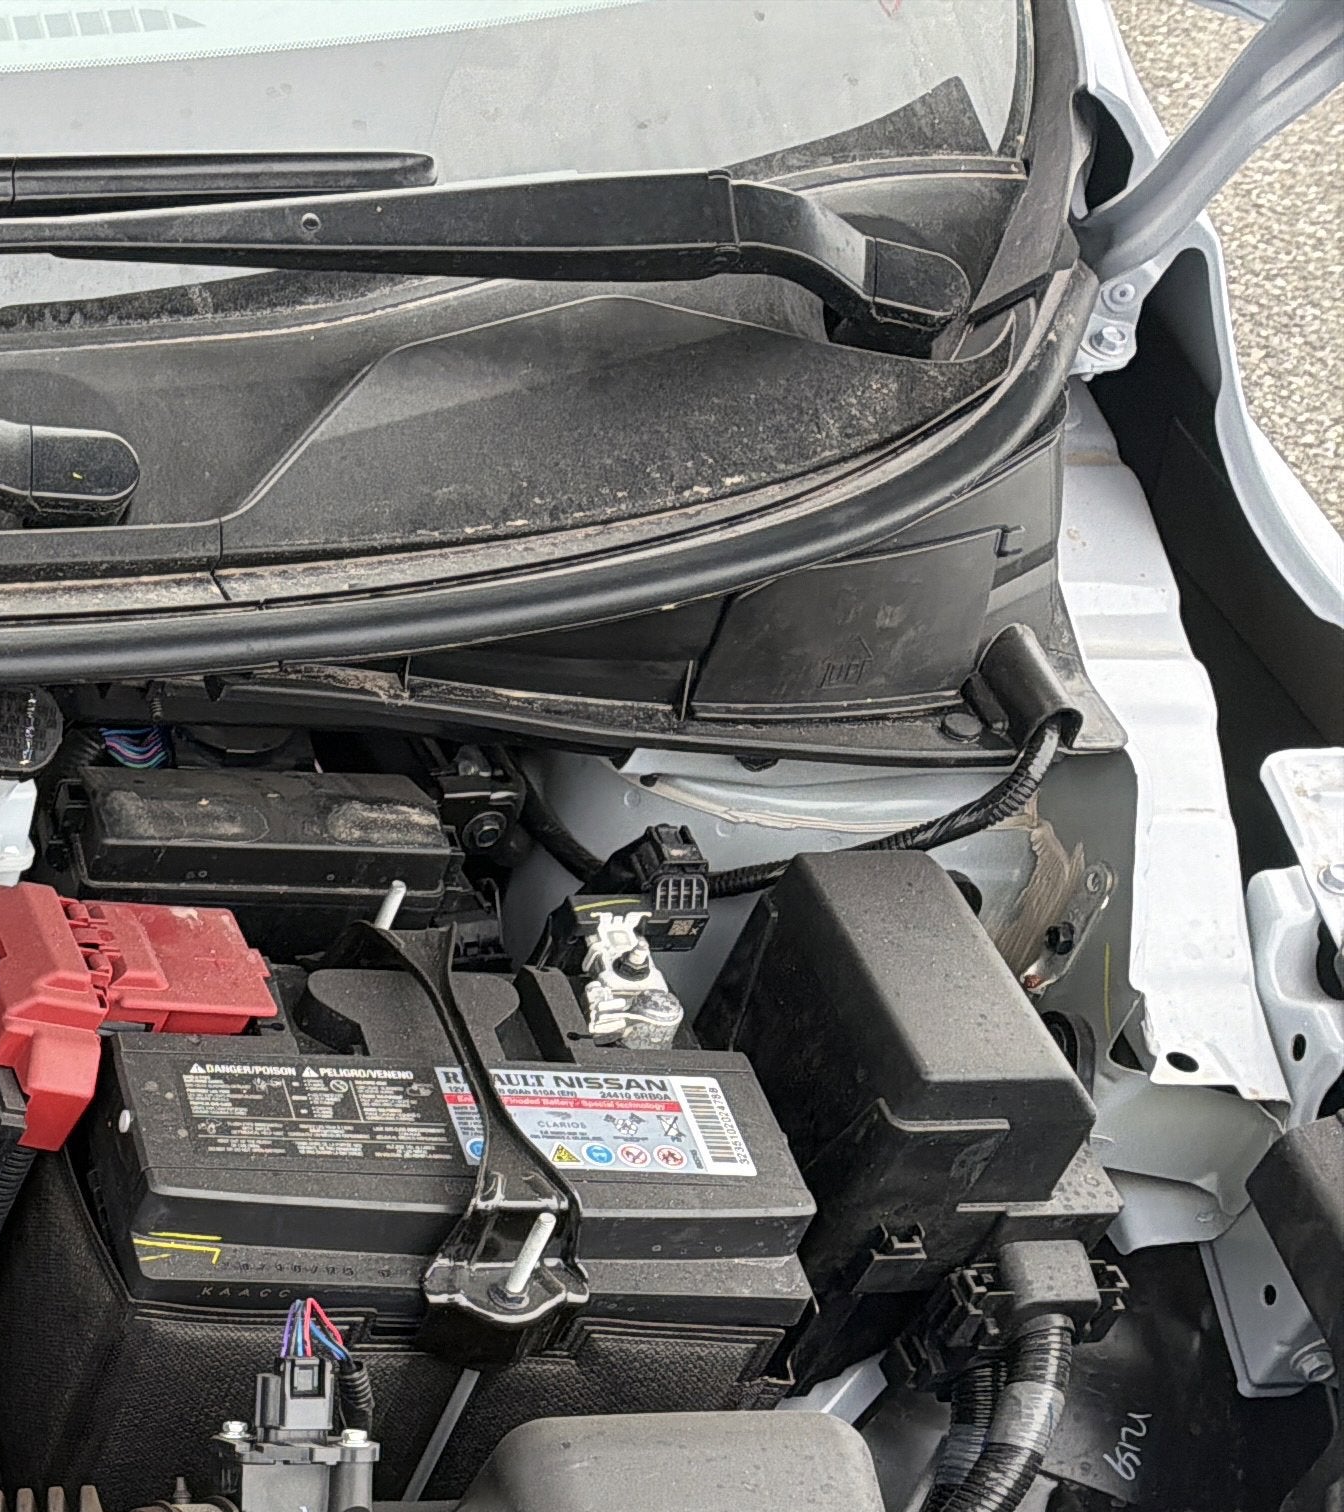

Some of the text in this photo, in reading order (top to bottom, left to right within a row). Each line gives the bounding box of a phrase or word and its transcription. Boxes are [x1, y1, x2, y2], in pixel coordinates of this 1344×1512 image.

[205, 1064, 297, 1077] DANGER/POISON
[319, 1067, 414, 1080] PELIGRO/VENENO
[442, 1071, 669, 1093] RAULT NISSAN
[537, 1120, 586, 1130] CLARIOS
